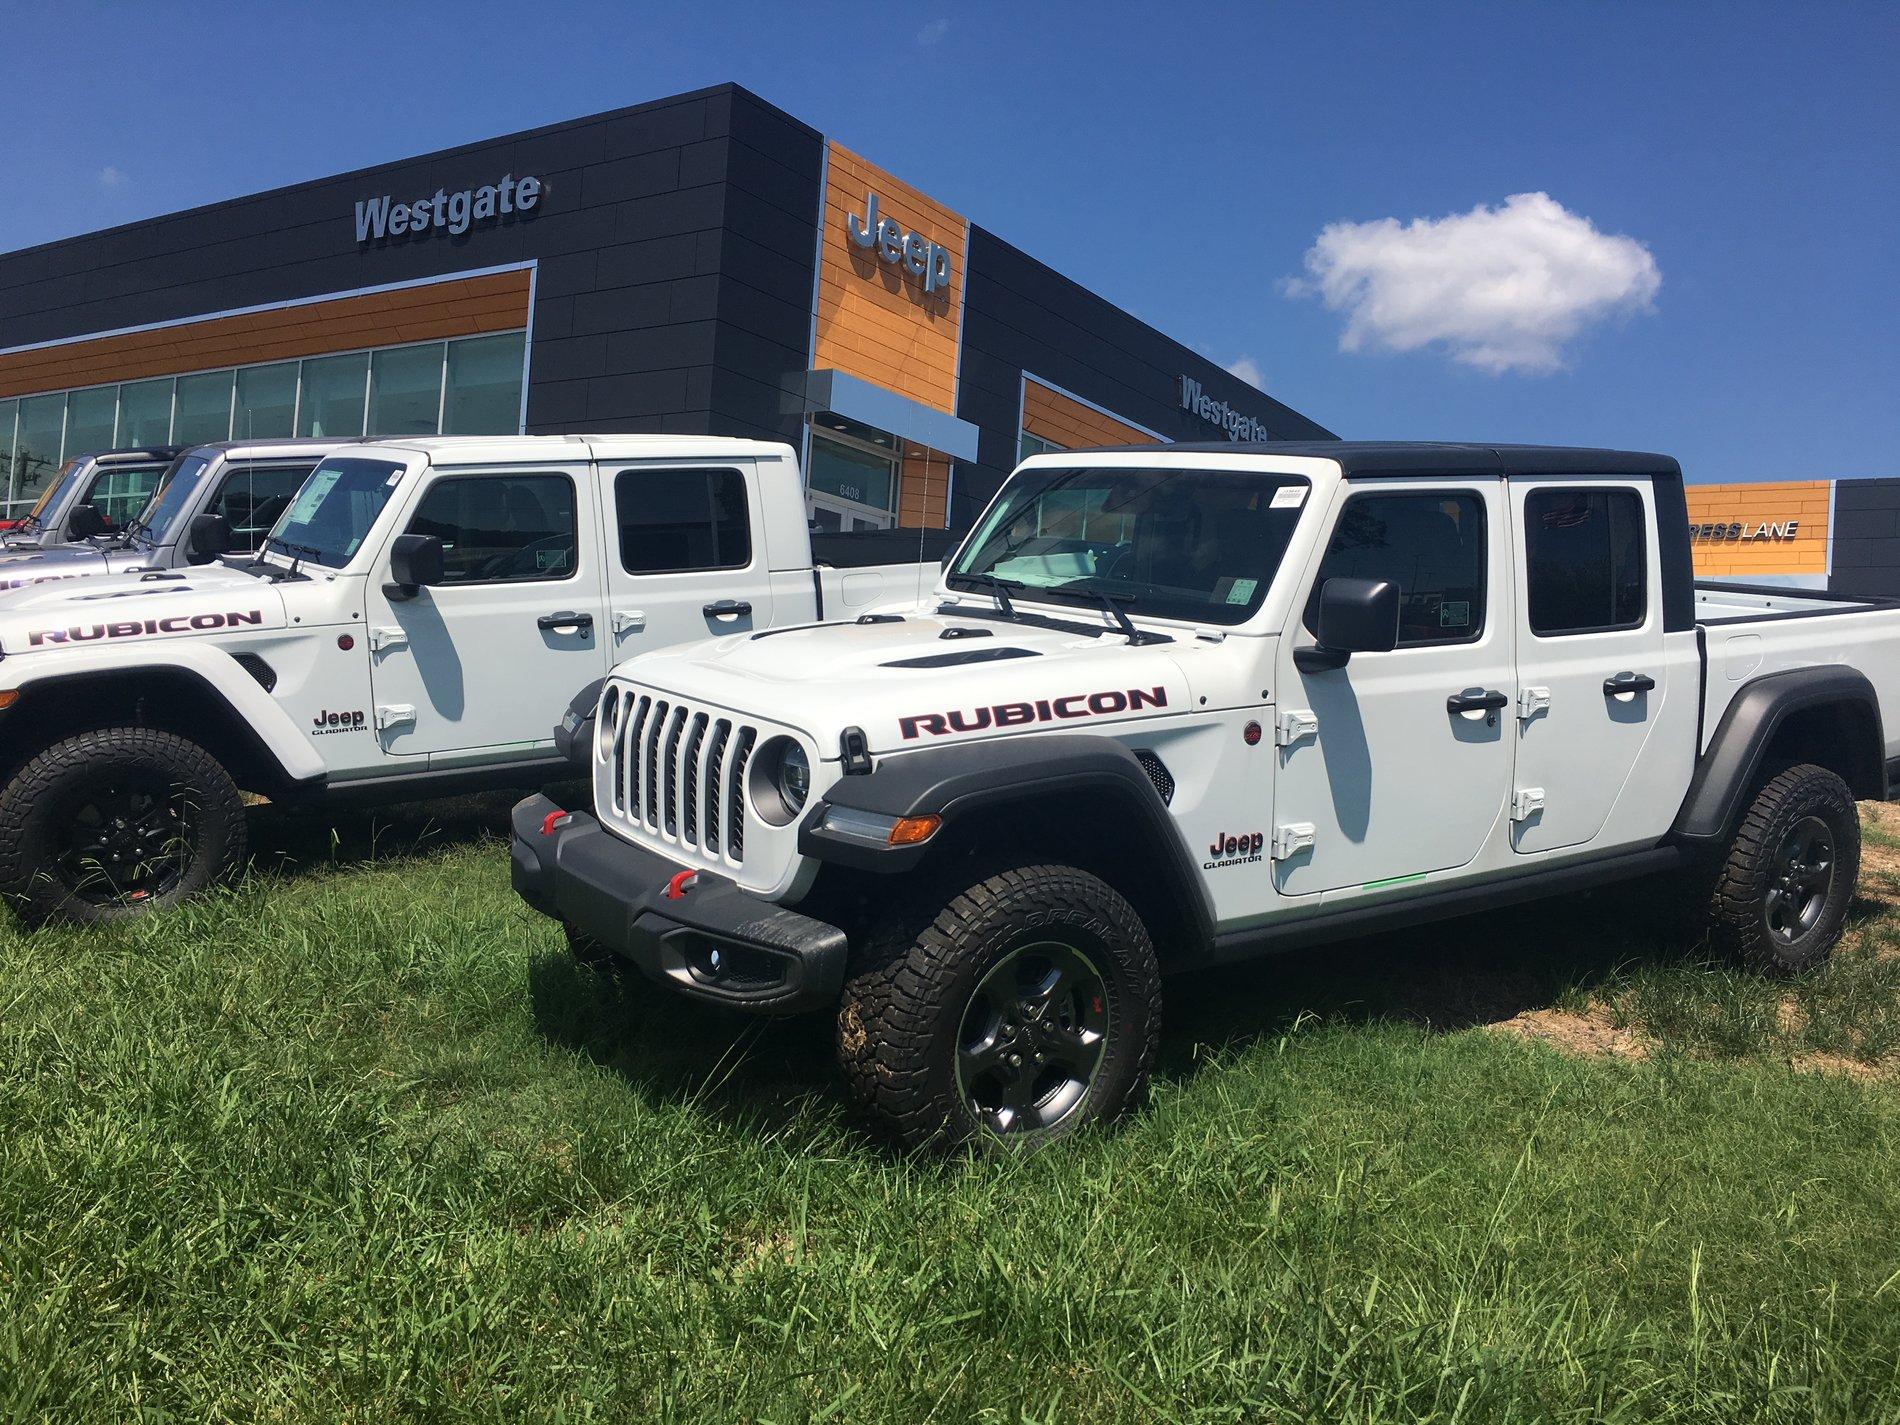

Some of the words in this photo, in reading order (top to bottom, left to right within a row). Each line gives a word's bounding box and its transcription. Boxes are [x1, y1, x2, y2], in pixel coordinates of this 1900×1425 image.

[354, 172, 541, 242] Westgate
[846, 191, 951, 293] Jeep
[1180, 374, 1268, 441] Westgate
[840, 483, 860, 500] 6408
[1742, 520, 1799, 539] LANE
[28, 610, 262, 646] RUBICON
[313, 710, 365, 727] Jeep
[898, 686, 1168, 739] RUBICON
[312, 725, 368, 736] GLADIATOR
[1209, 832, 1264, 856] Jeep
[1203, 855, 1262, 870] GLADIATOR
